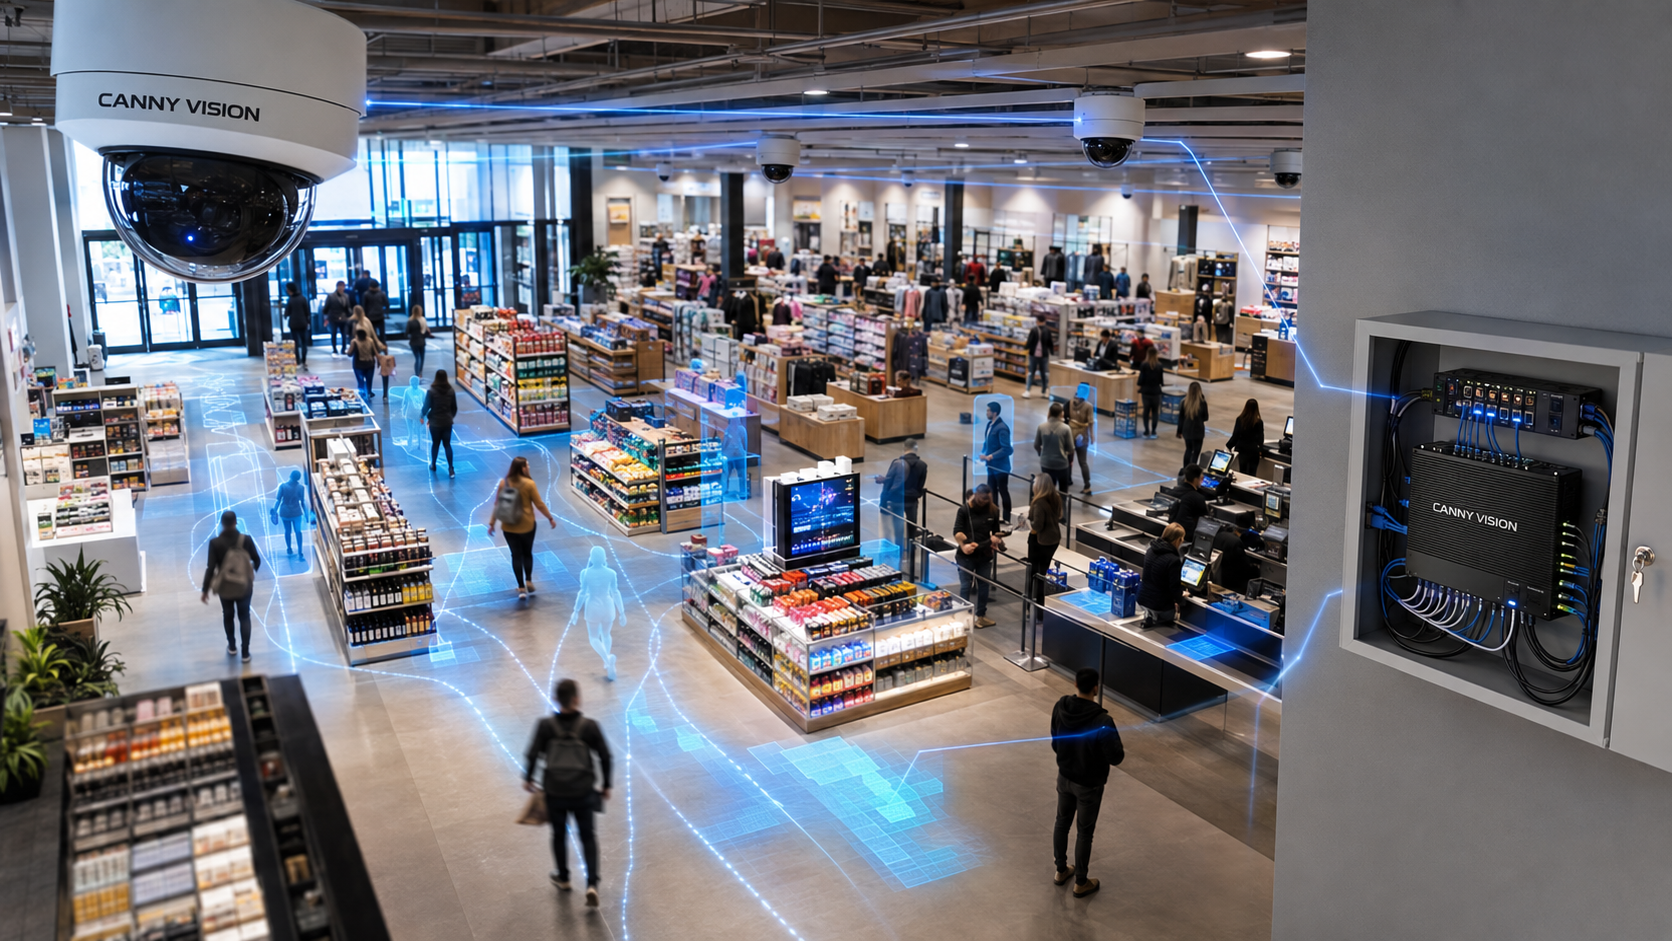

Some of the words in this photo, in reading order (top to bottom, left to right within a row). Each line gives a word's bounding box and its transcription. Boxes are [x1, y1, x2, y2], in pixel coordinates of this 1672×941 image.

[98, 92, 181, 112] CANNY
[185, 98, 260, 122] VISION
[1433, 503, 1474, 520] CANNY
[1476, 513, 1518, 532] VISION
